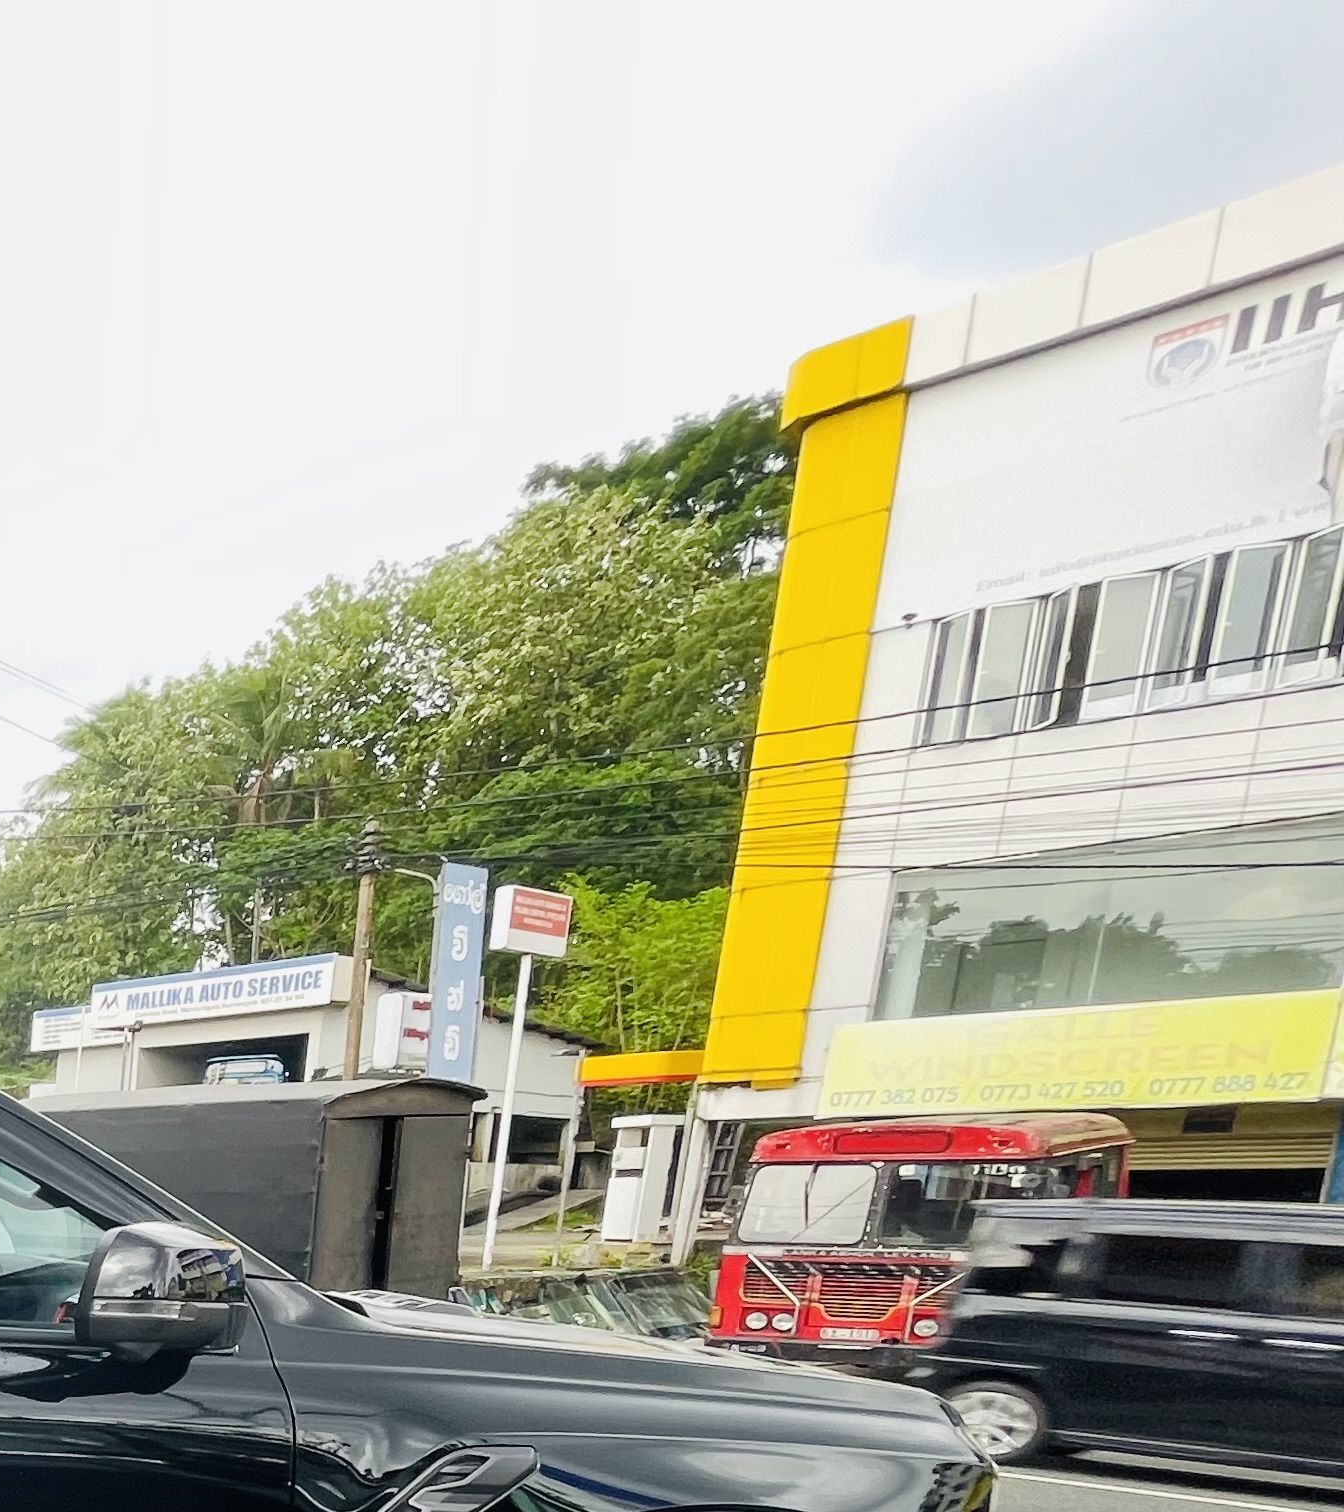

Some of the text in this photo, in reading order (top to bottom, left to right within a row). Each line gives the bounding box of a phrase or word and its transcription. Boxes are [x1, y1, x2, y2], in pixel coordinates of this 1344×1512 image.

[126, 985, 194, 1011] MALLIKA
[199, 979, 243, 1003] AUTO
[248, 970, 324, 997] SERVICE
[869, 1040, 1274, 1083] WINDSCREEN
[830, 1089, 877, 1108] 0777
[880, 1088, 916, 1106] 382
[921, 1086, 960, 1104] 075
[1038, 1081, 1078, 1099] 427
[1148, 1076, 1206, 1097] 0777
[1212, 1075, 1254, 1094] 888
[1263, 1071, 1310, 1091] 427
